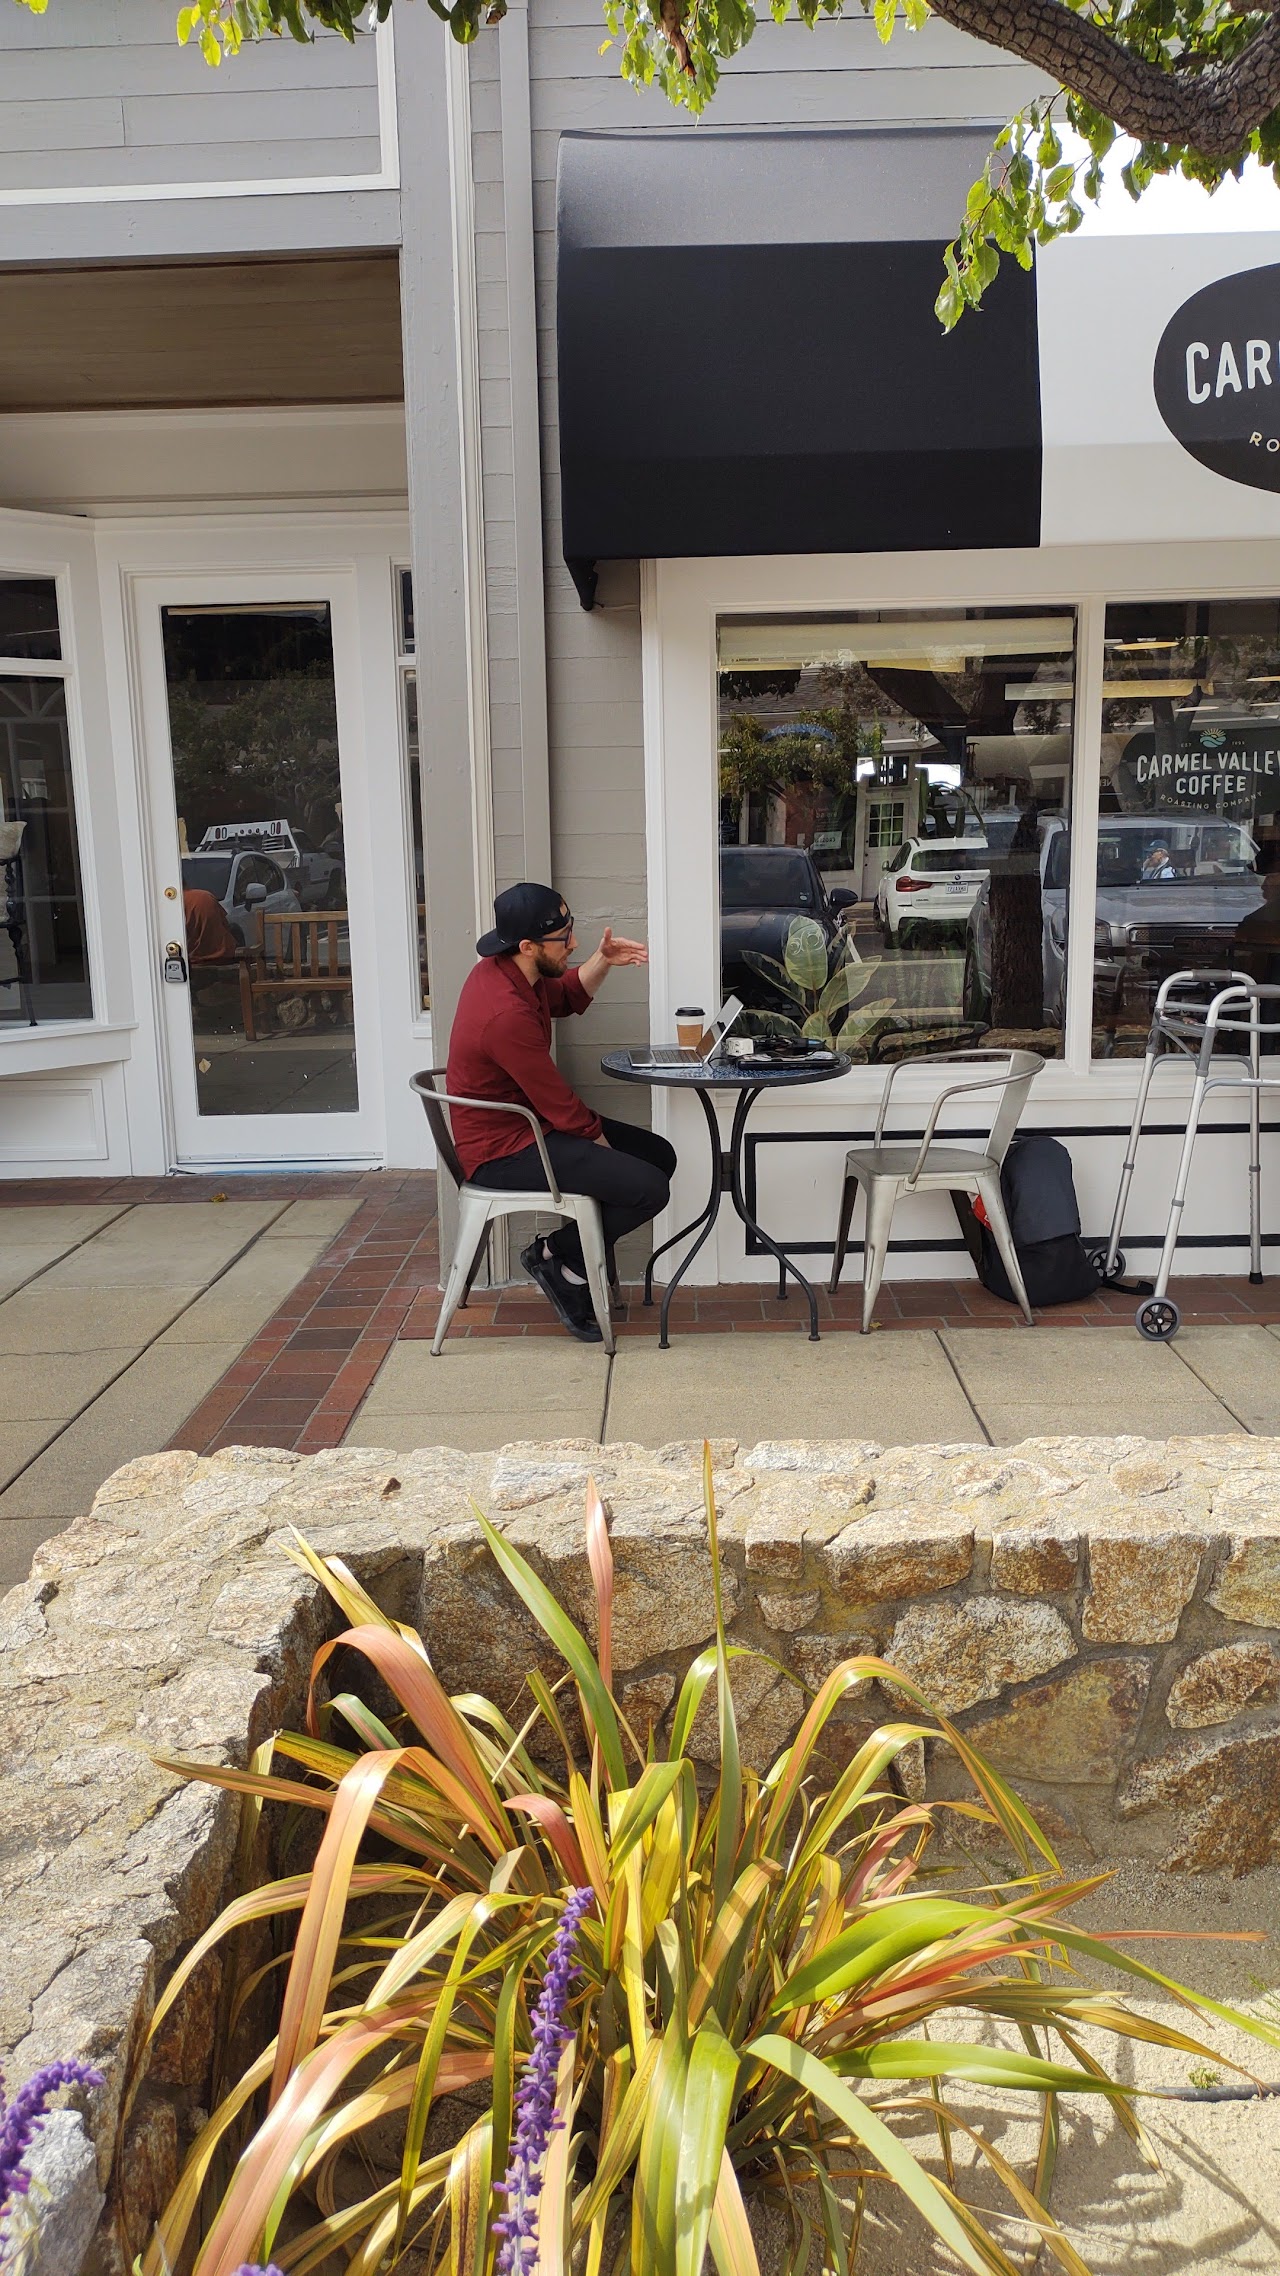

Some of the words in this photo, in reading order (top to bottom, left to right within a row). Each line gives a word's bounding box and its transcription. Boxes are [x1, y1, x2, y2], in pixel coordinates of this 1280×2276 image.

[1185, 340, 1280, 404] CAR
[1136, 752, 1212, 783] CARMEL
[1176, 774, 1247, 795] COFFEE
[1160, 794, 1210, 810] ROASTING
[1216, 791, 1263, 809] COMPANY
